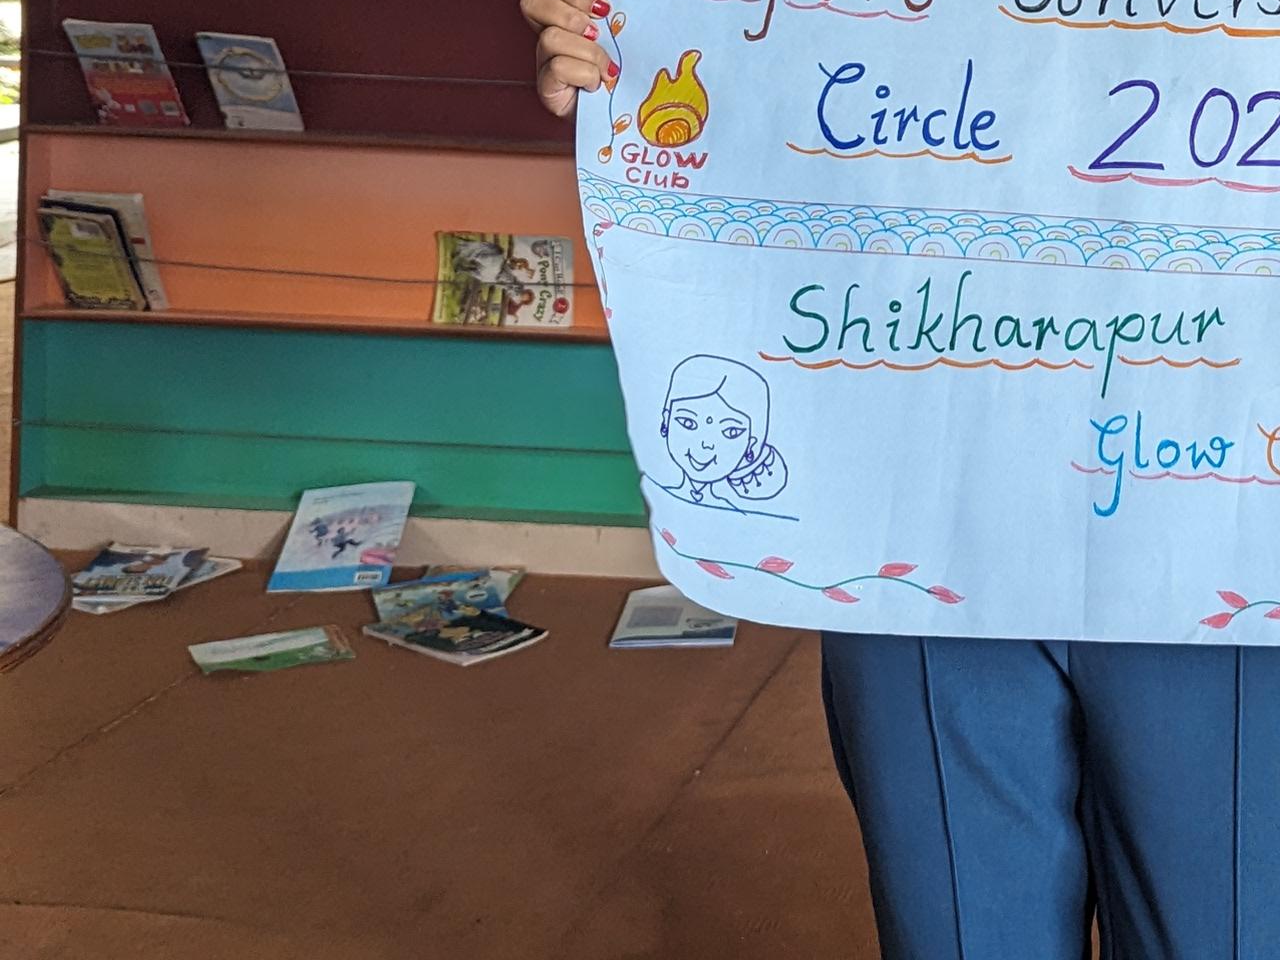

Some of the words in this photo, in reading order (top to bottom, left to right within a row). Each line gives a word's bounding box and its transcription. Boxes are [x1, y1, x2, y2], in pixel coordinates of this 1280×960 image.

[818, 59, 1000, 153] Circle
[621, 143, 708, 169] GLOW
[534, 290, 552, 321] Crazy
[783, 271, 1226, 399] Shikharapur
[1090, 410, 1236, 517] Glow
